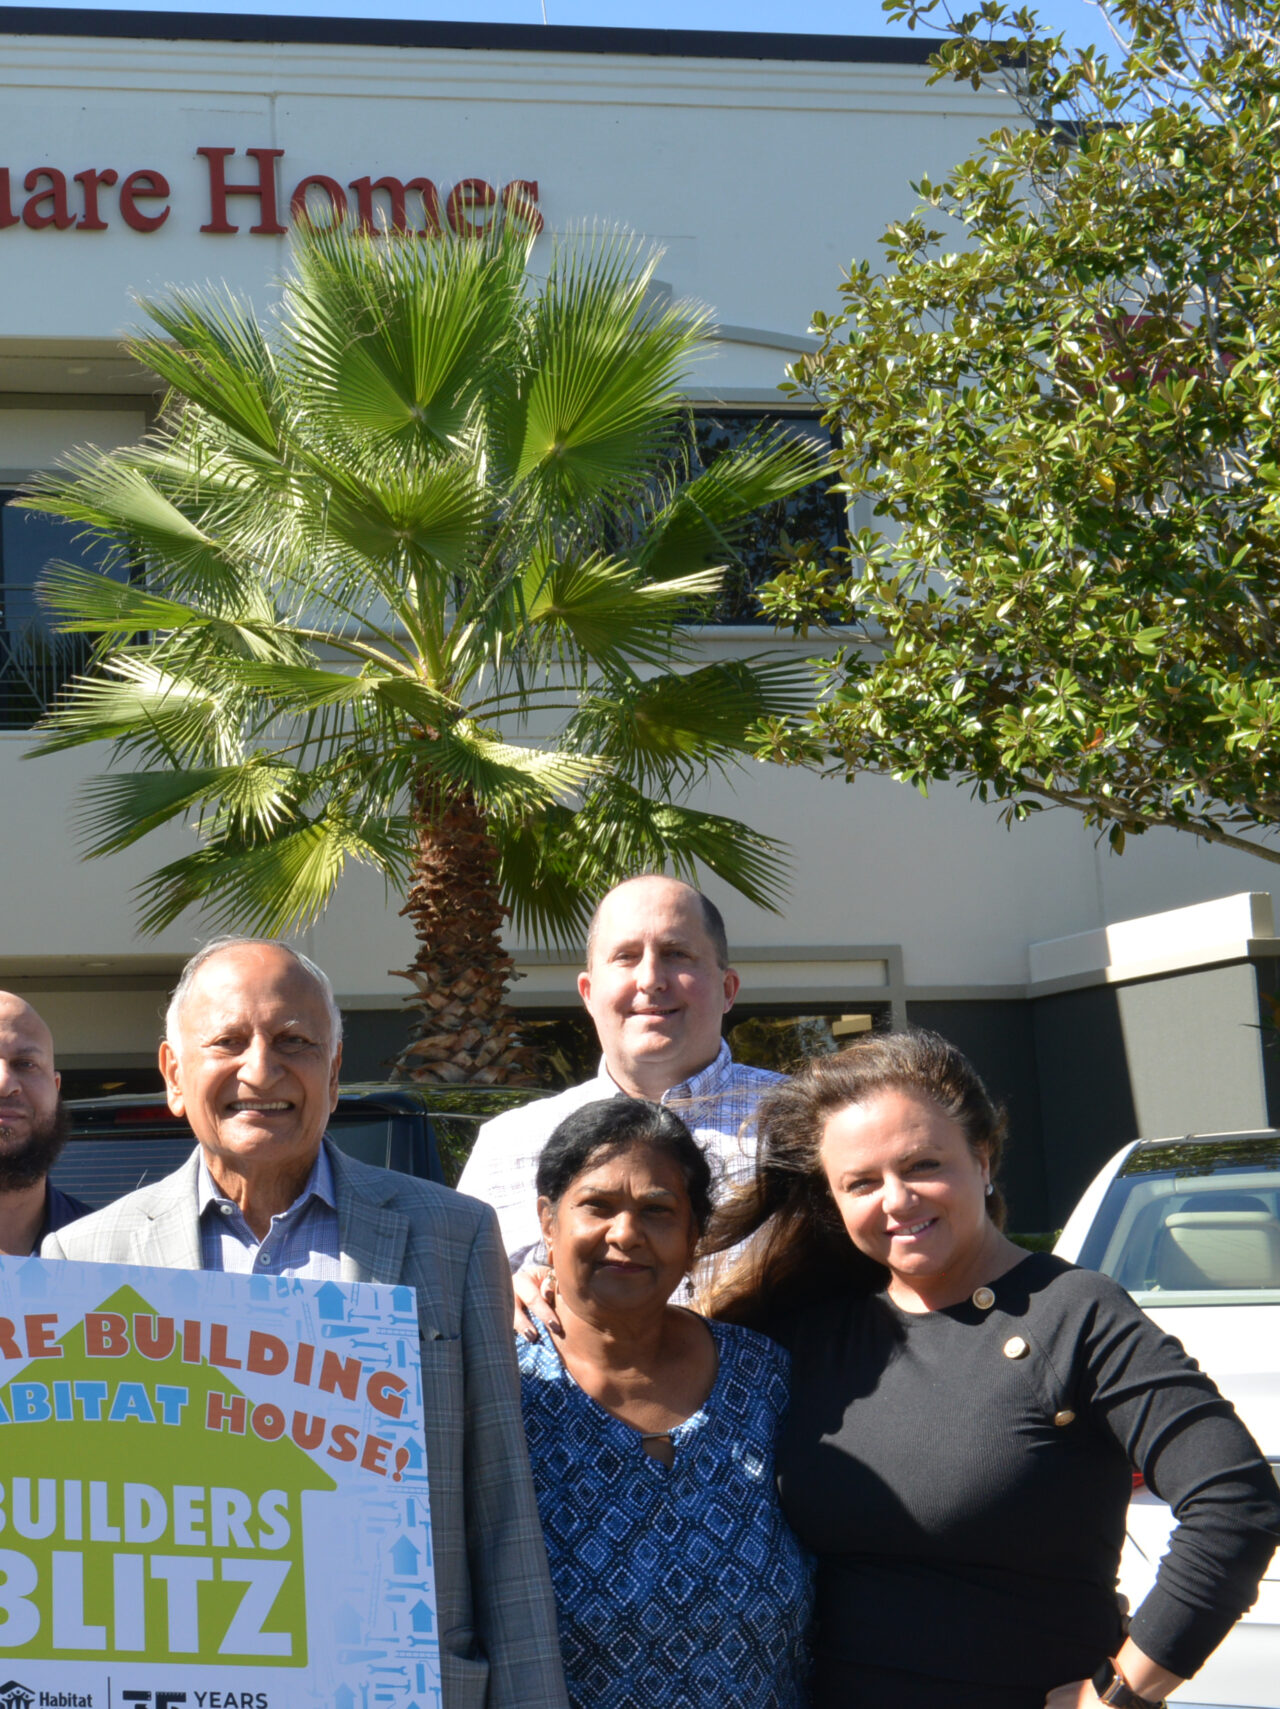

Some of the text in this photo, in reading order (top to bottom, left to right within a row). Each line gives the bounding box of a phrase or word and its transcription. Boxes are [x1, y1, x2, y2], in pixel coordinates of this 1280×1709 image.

[196, 146, 545, 239] Homes
[84, 1311, 410, 1419] BUILDING
[204, 1391, 412, 1483] HOUSE!
[39, 1691, 93, 1708] Habitat
[193, 1691, 268, 1709] YEARS
